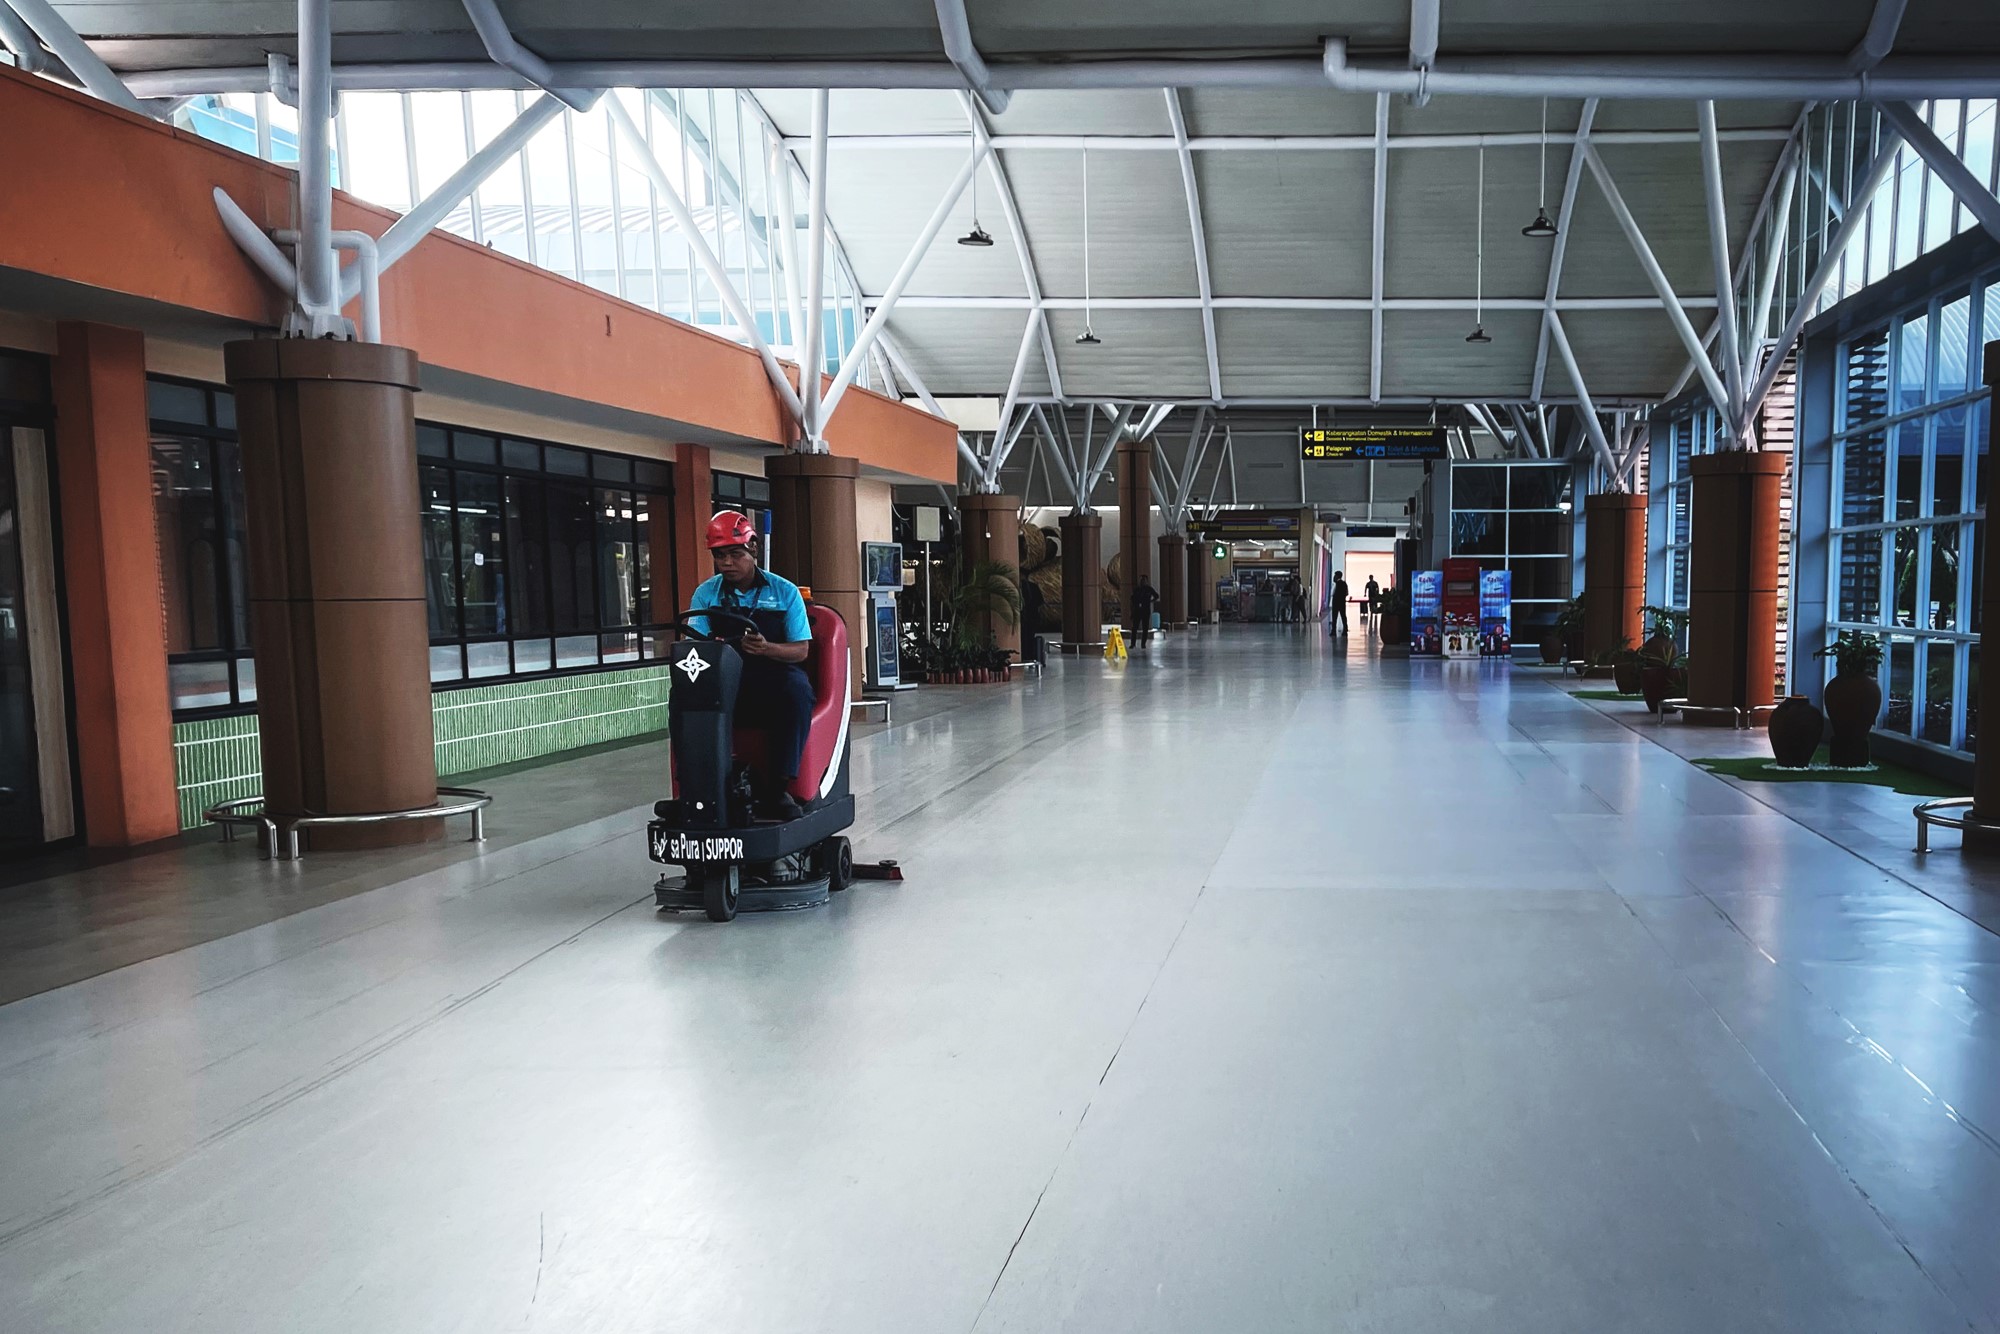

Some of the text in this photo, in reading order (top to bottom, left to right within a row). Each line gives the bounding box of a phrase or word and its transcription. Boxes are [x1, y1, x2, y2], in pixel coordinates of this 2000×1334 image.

[1326, 430, 1366, 438] Keberangkatan
[680, 832, 700, 860] Pura
[706, 837, 744, 860] SUPPOR
